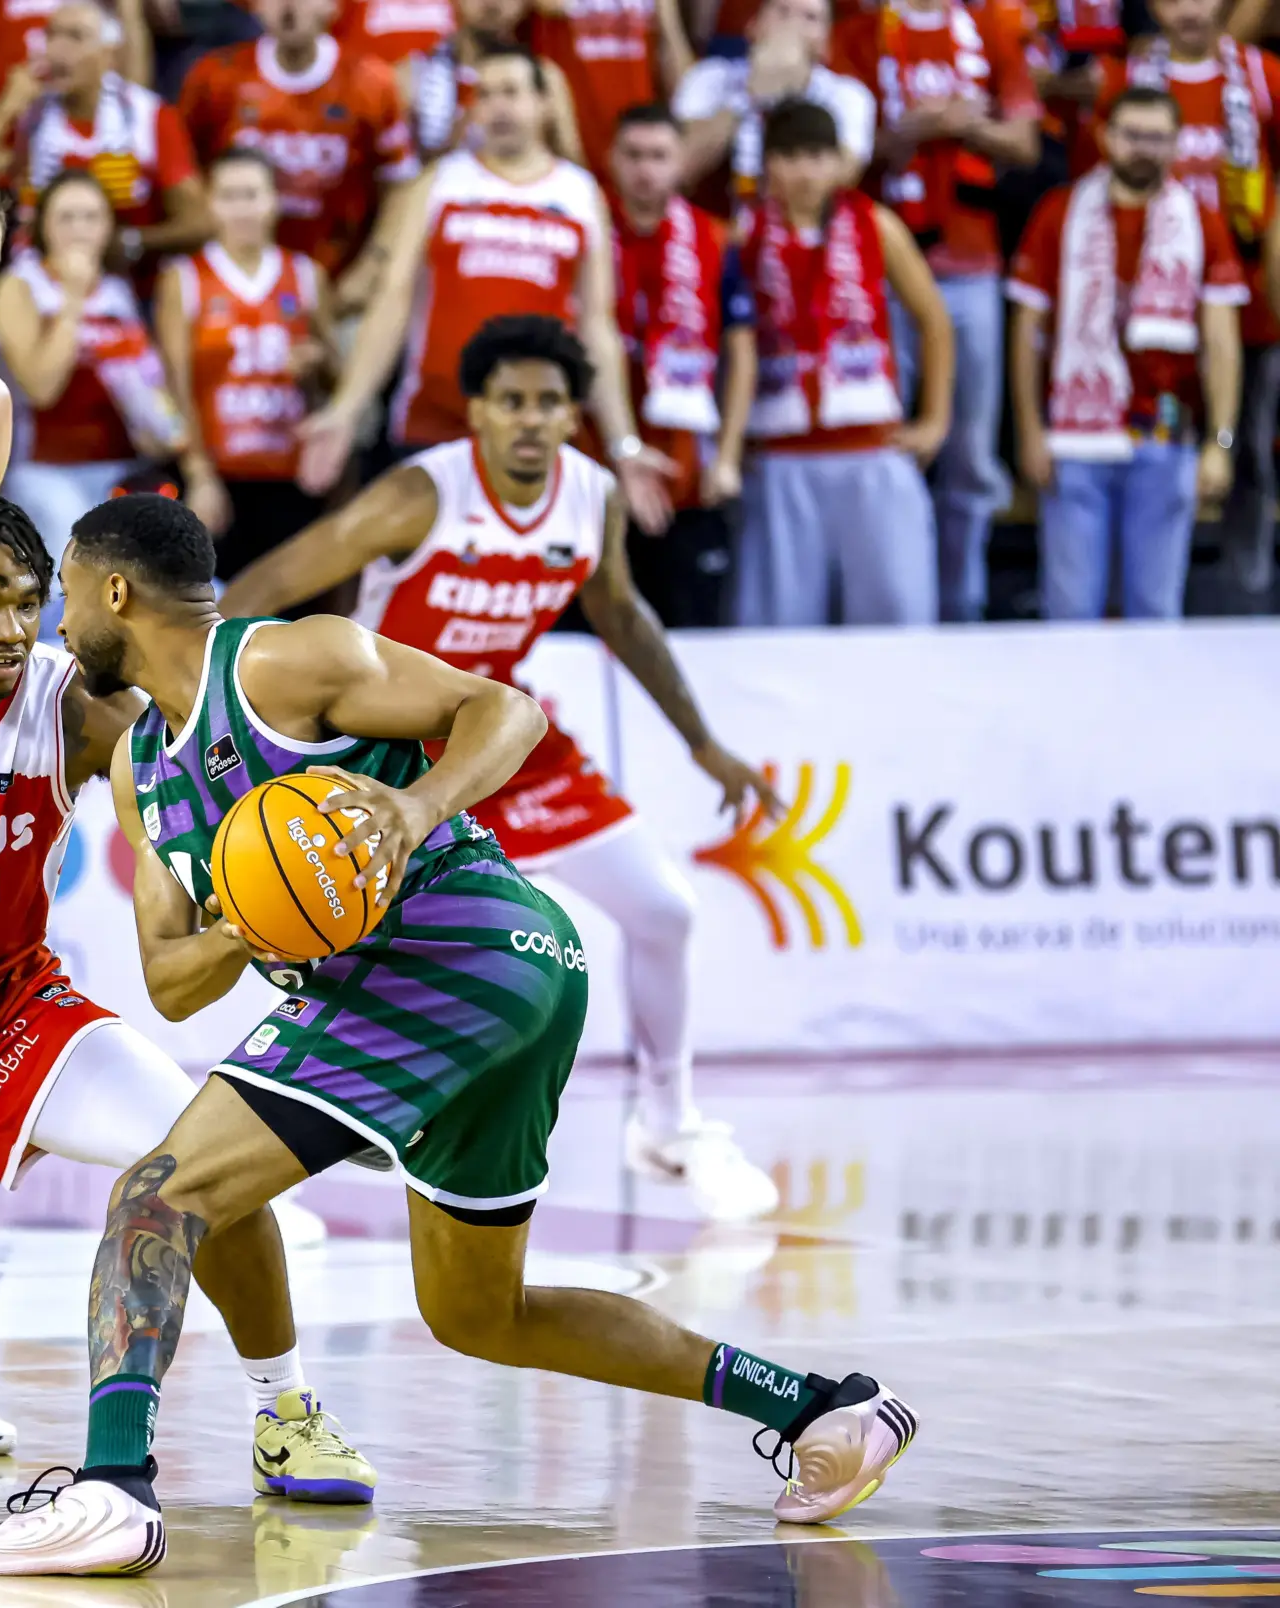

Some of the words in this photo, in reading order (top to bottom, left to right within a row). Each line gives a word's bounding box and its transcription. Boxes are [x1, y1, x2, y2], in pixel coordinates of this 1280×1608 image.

[286, 816, 313, 852] liga
[305, 850, 346, 919] endesa
[892, 800, 1280, 893] Kouten
[280, 1003, 297, 1014] acb
[732, 1354, 800, 1401] UNICAJA
